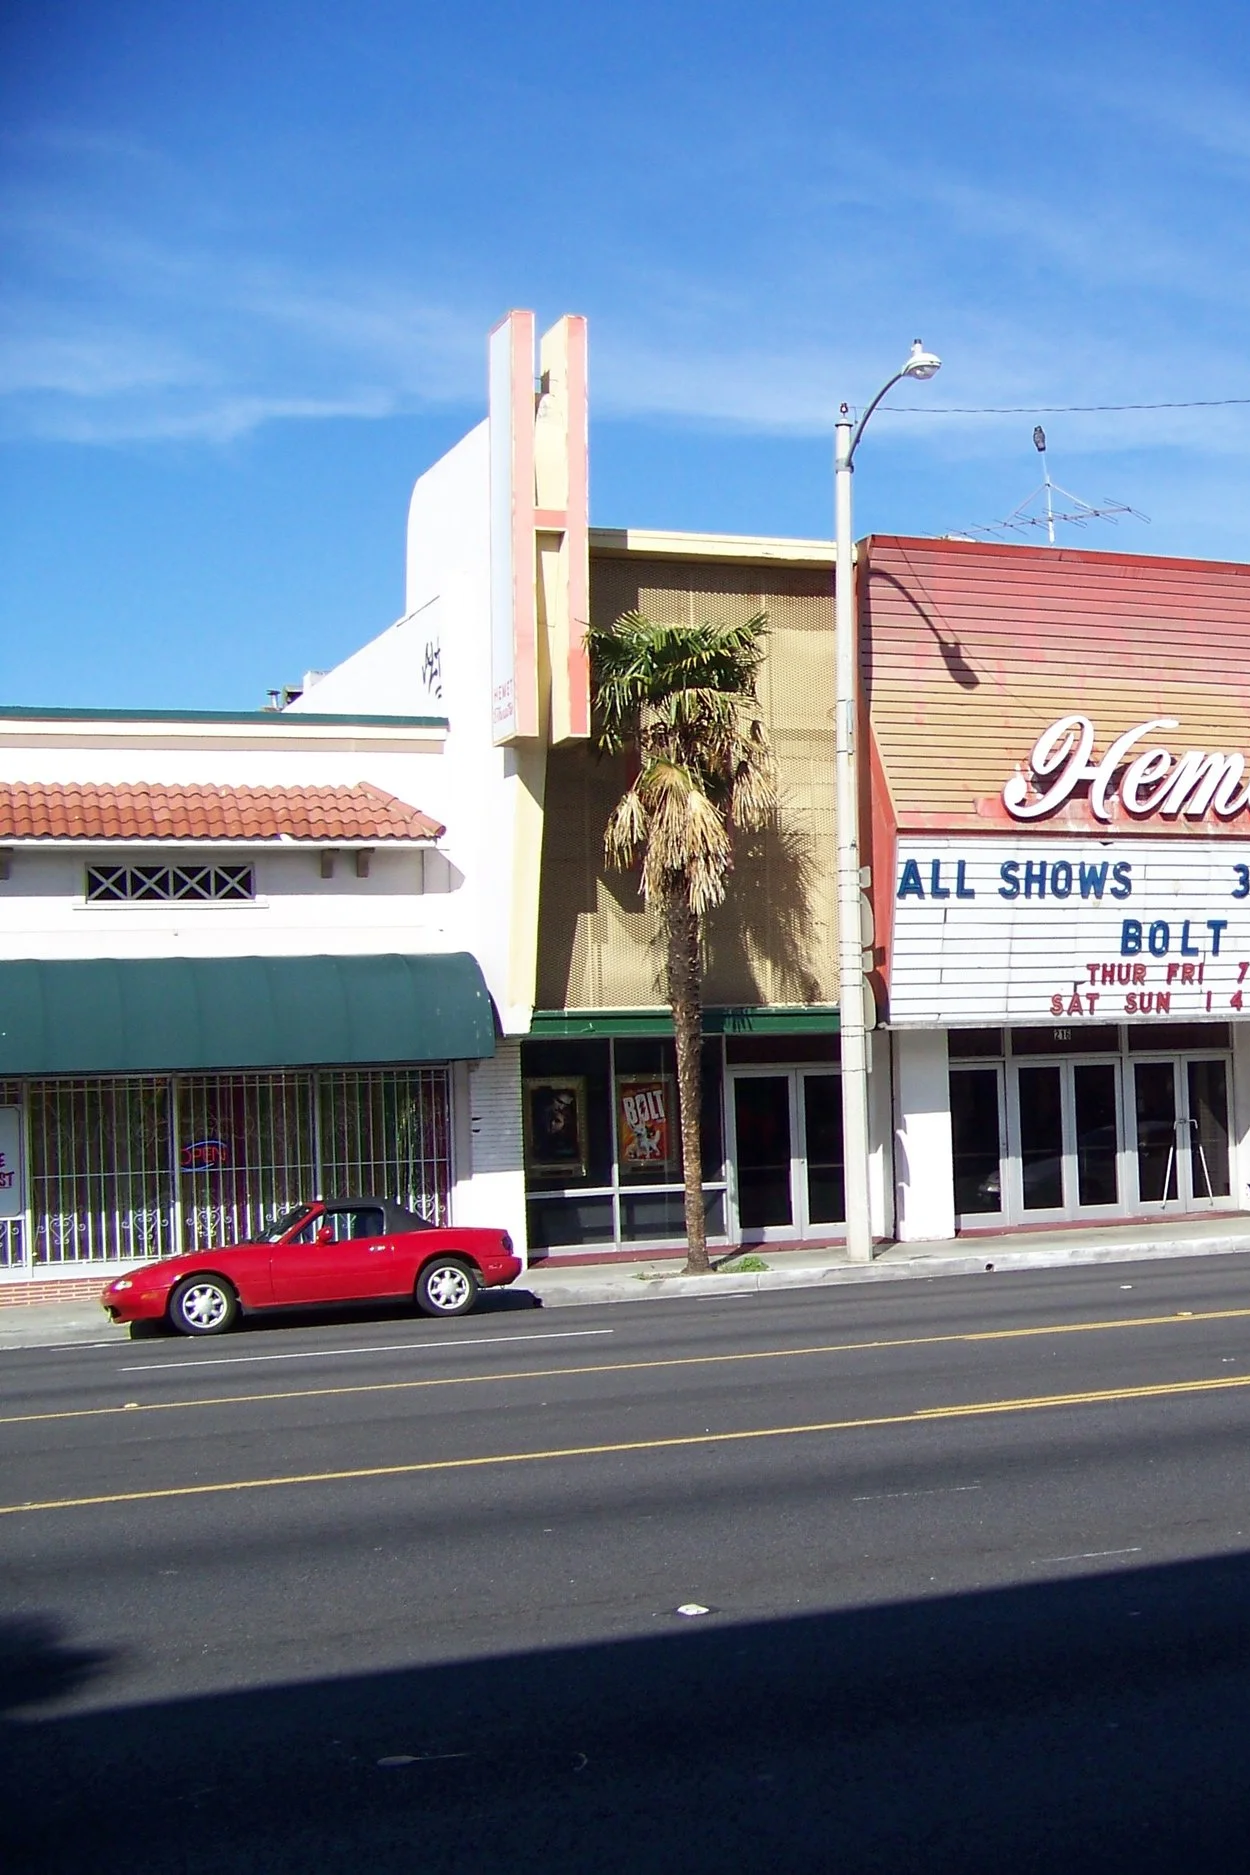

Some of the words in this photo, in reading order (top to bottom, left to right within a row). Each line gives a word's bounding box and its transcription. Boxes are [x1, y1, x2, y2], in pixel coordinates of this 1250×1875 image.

[897, 858, 975, 900] ALL
[998, 860, 1133, 900] SHOWS
[1231, 863, 1250, 899] 3
[1121, 919, 1228, 957] BOLT
[1086, 963, 1147, 986] THUR
[1166, 962, 1205, 985] FRI
[1237, 962, 1250, 984] 7
[1050, 992, 1100, 1016] SAT
[1124, 991, 1171, 1014] SUN
[1230, 990, 1243, 1012] 4
[623, 1090, 665, 1126] BOLT
[180, 1146, 227, 1166] OPEN
